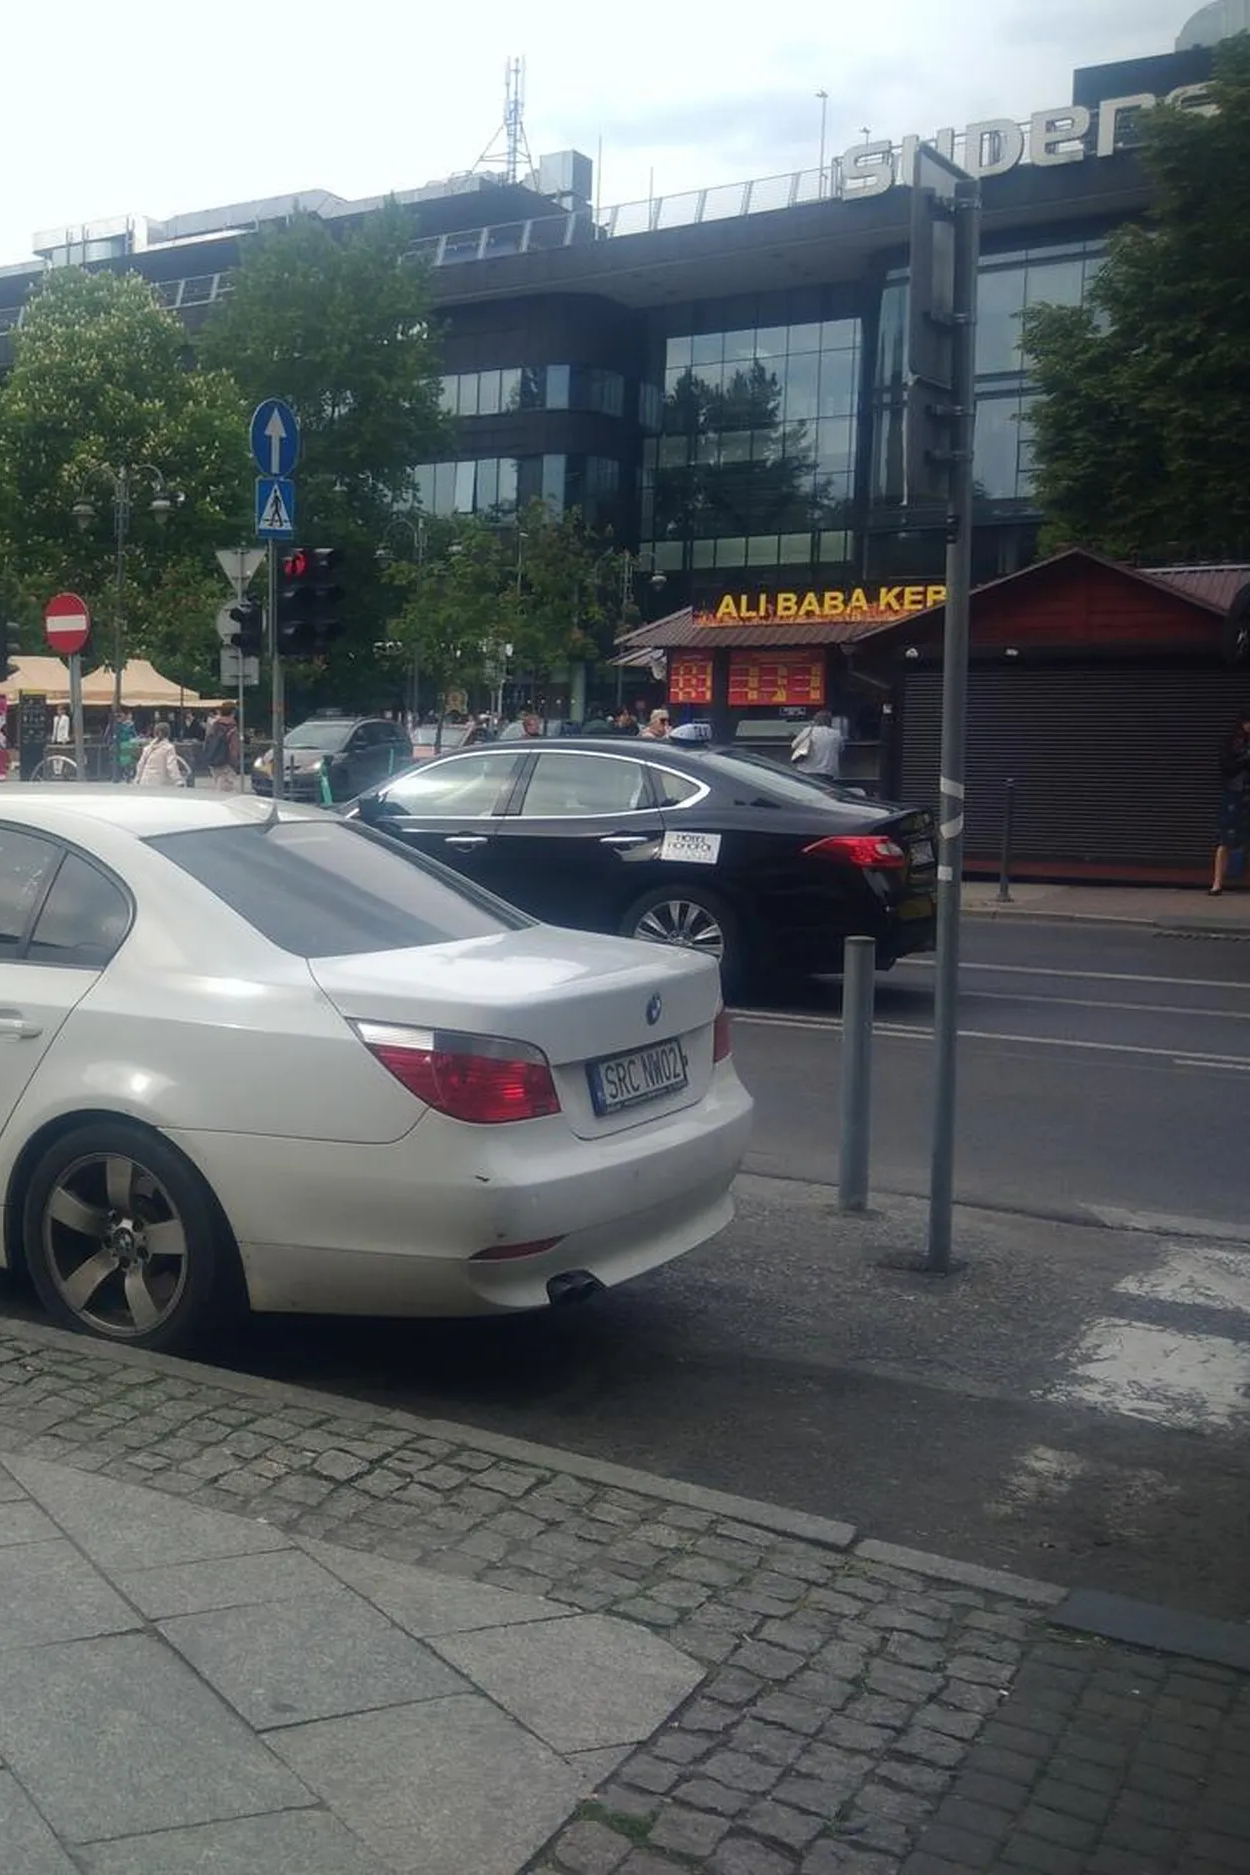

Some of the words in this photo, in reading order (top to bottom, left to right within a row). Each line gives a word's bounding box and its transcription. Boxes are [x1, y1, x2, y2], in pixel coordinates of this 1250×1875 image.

[716, 594, 766, 621] ALI
[776, 588, 868, 616] BABA
[605, 1060, 640, 1099] SRC
